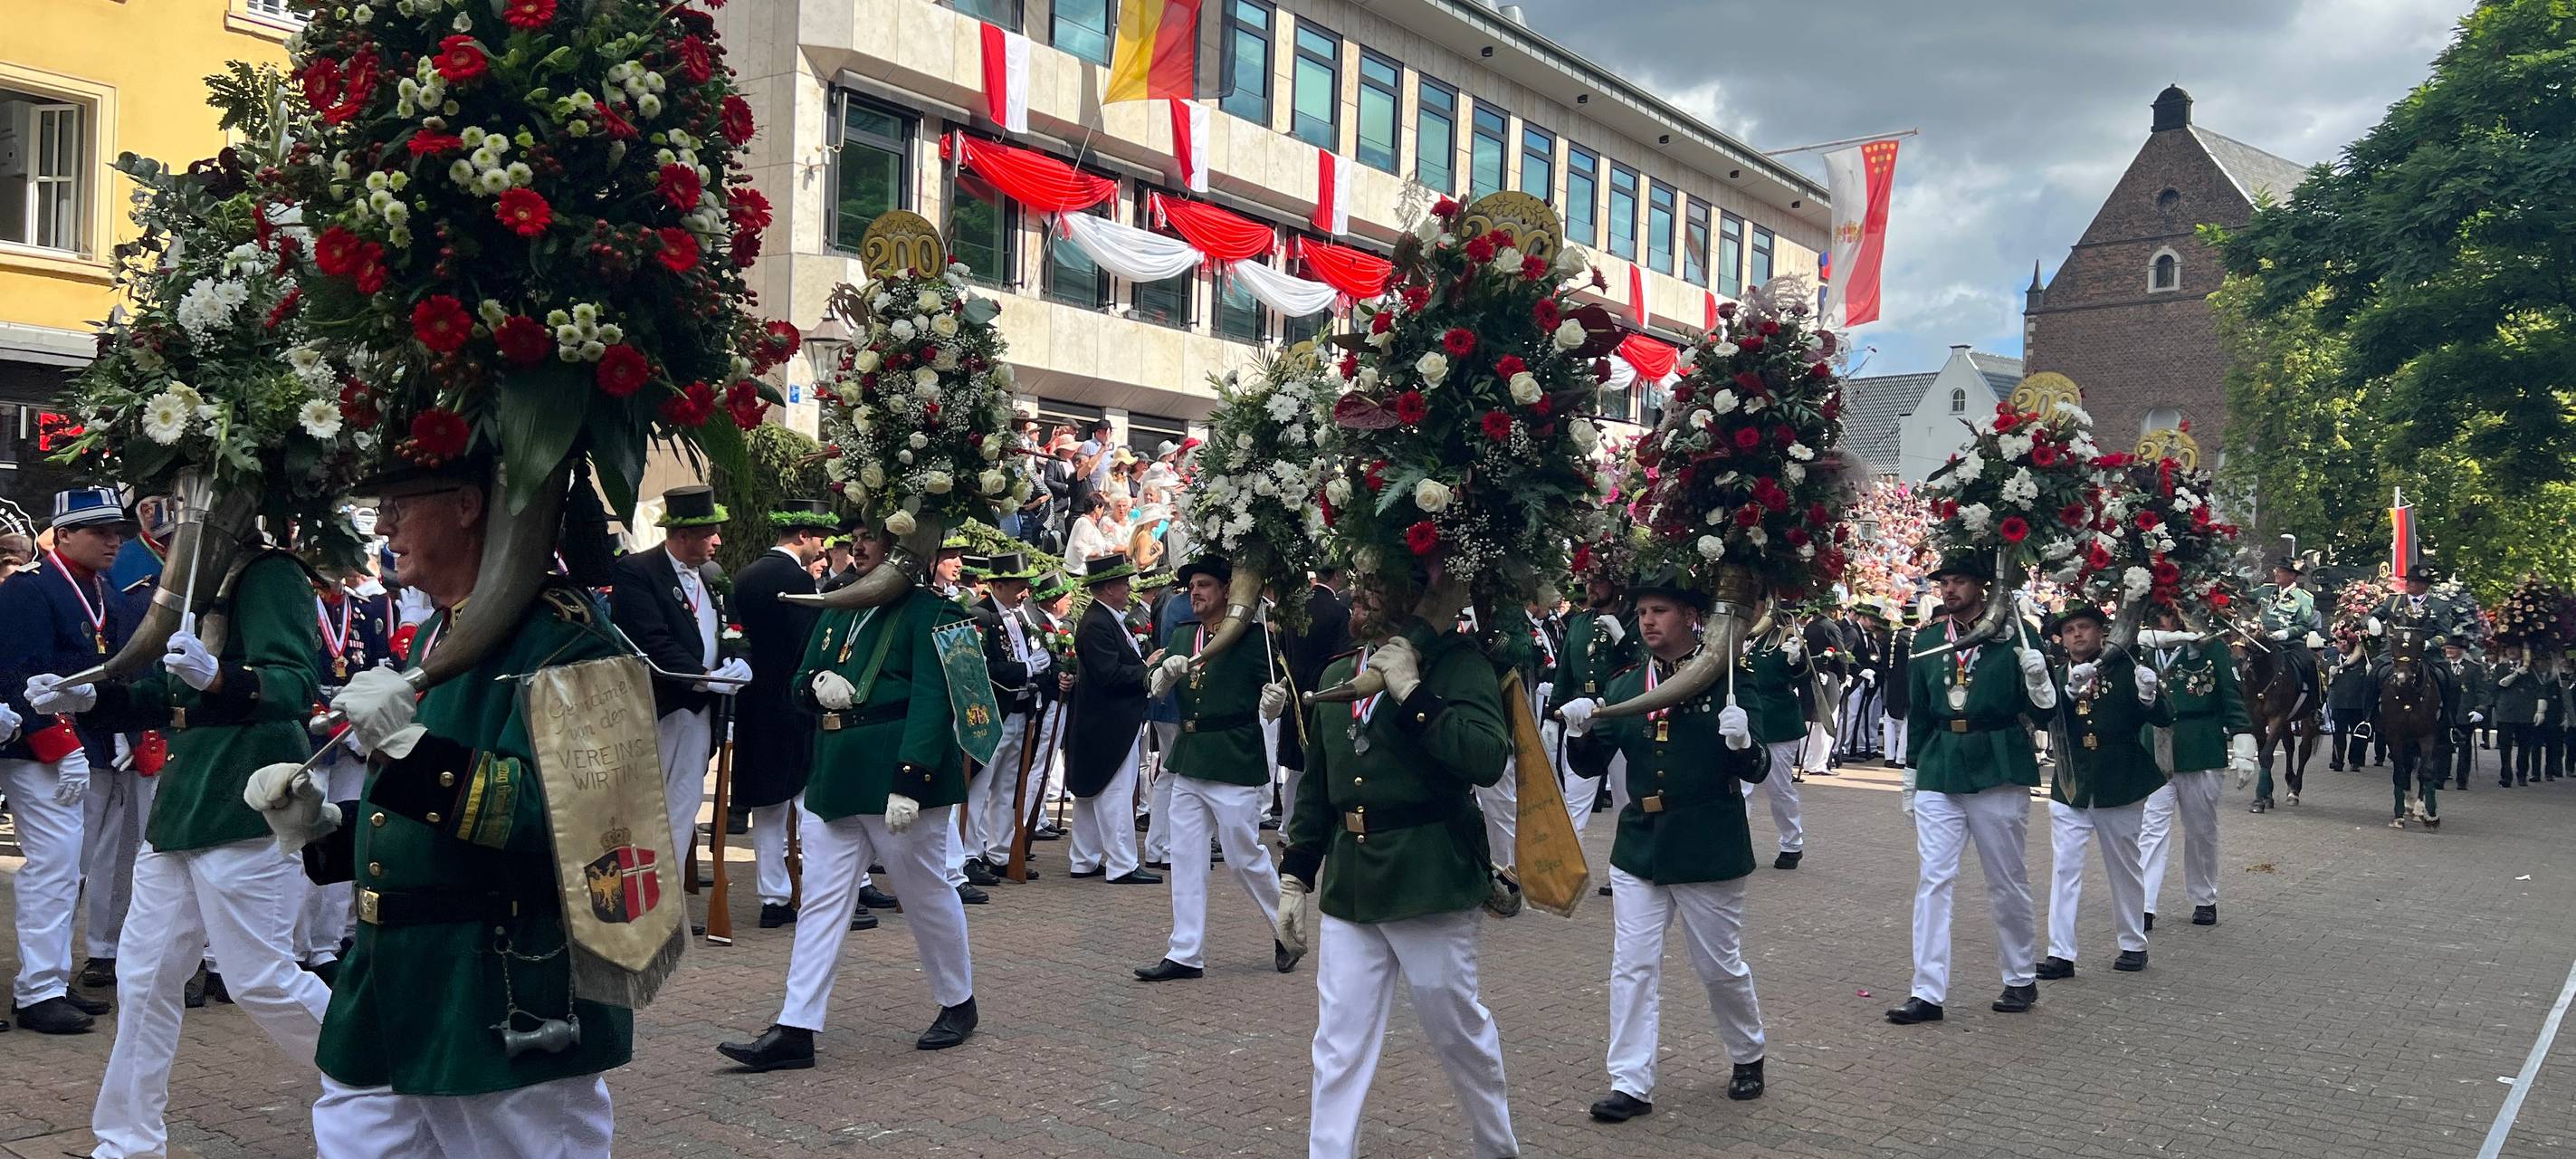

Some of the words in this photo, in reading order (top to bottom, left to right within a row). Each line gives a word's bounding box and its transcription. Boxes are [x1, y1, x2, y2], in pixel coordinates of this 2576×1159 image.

[865, 235, 940, 279] 200
[557, 738, 645, 771] VEREINS
[570, 764, 639, 791] WIRTIN
